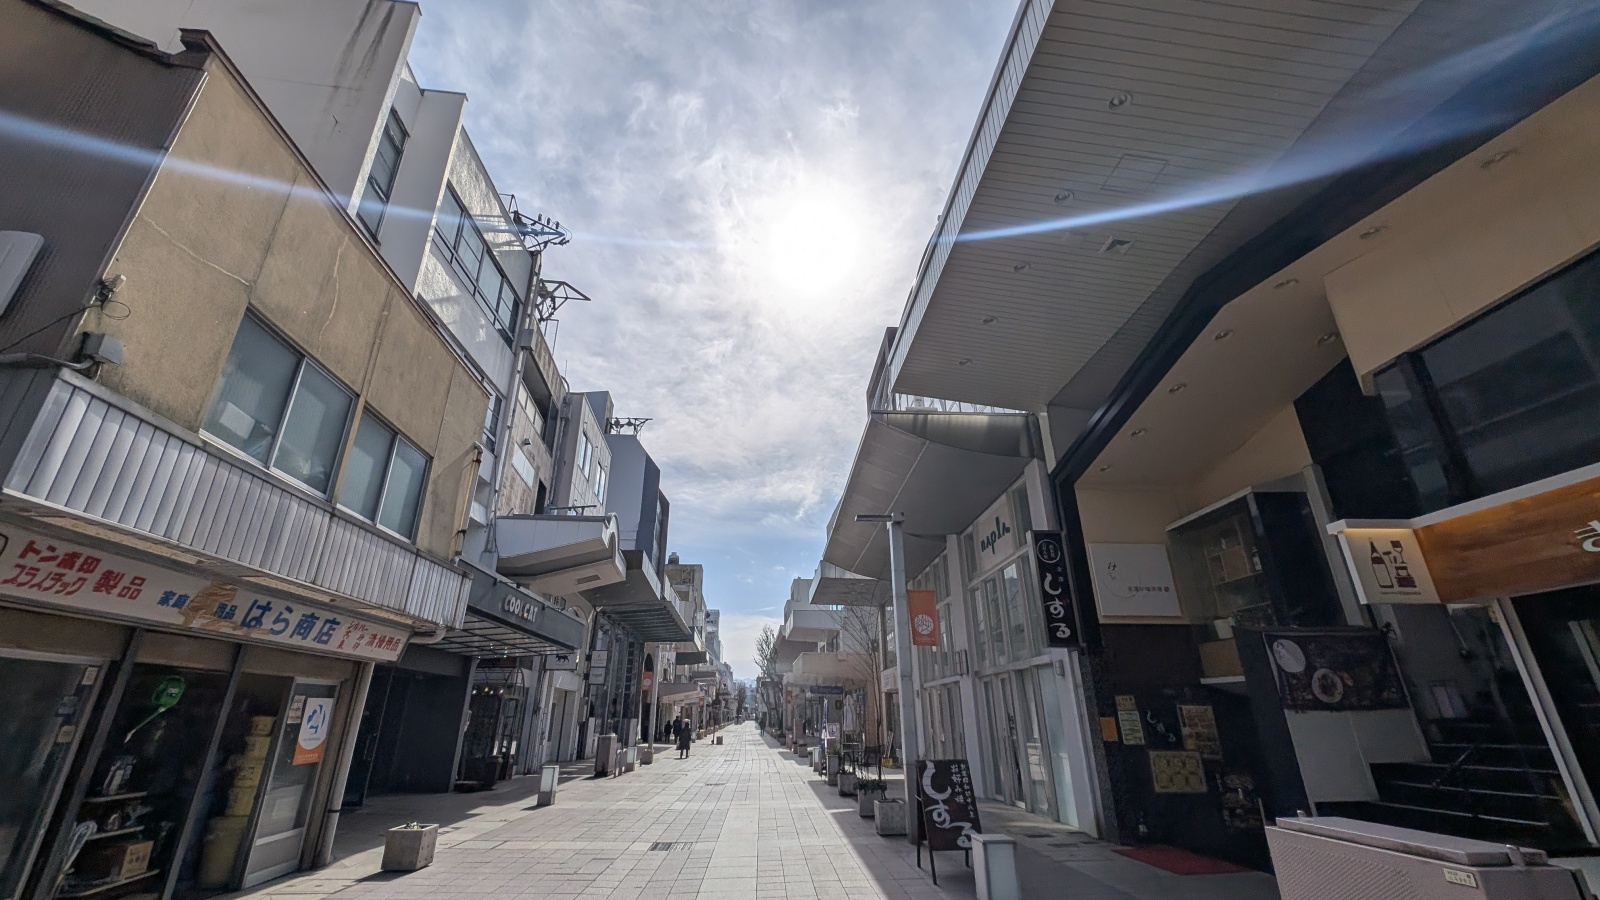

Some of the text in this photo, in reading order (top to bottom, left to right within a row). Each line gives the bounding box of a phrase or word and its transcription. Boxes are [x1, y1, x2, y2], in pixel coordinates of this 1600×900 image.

[92, 569, 147, 600] 製品
[240, 599, 341, 645] はら商店
[504, 594, 539, 622] COOL CAT
